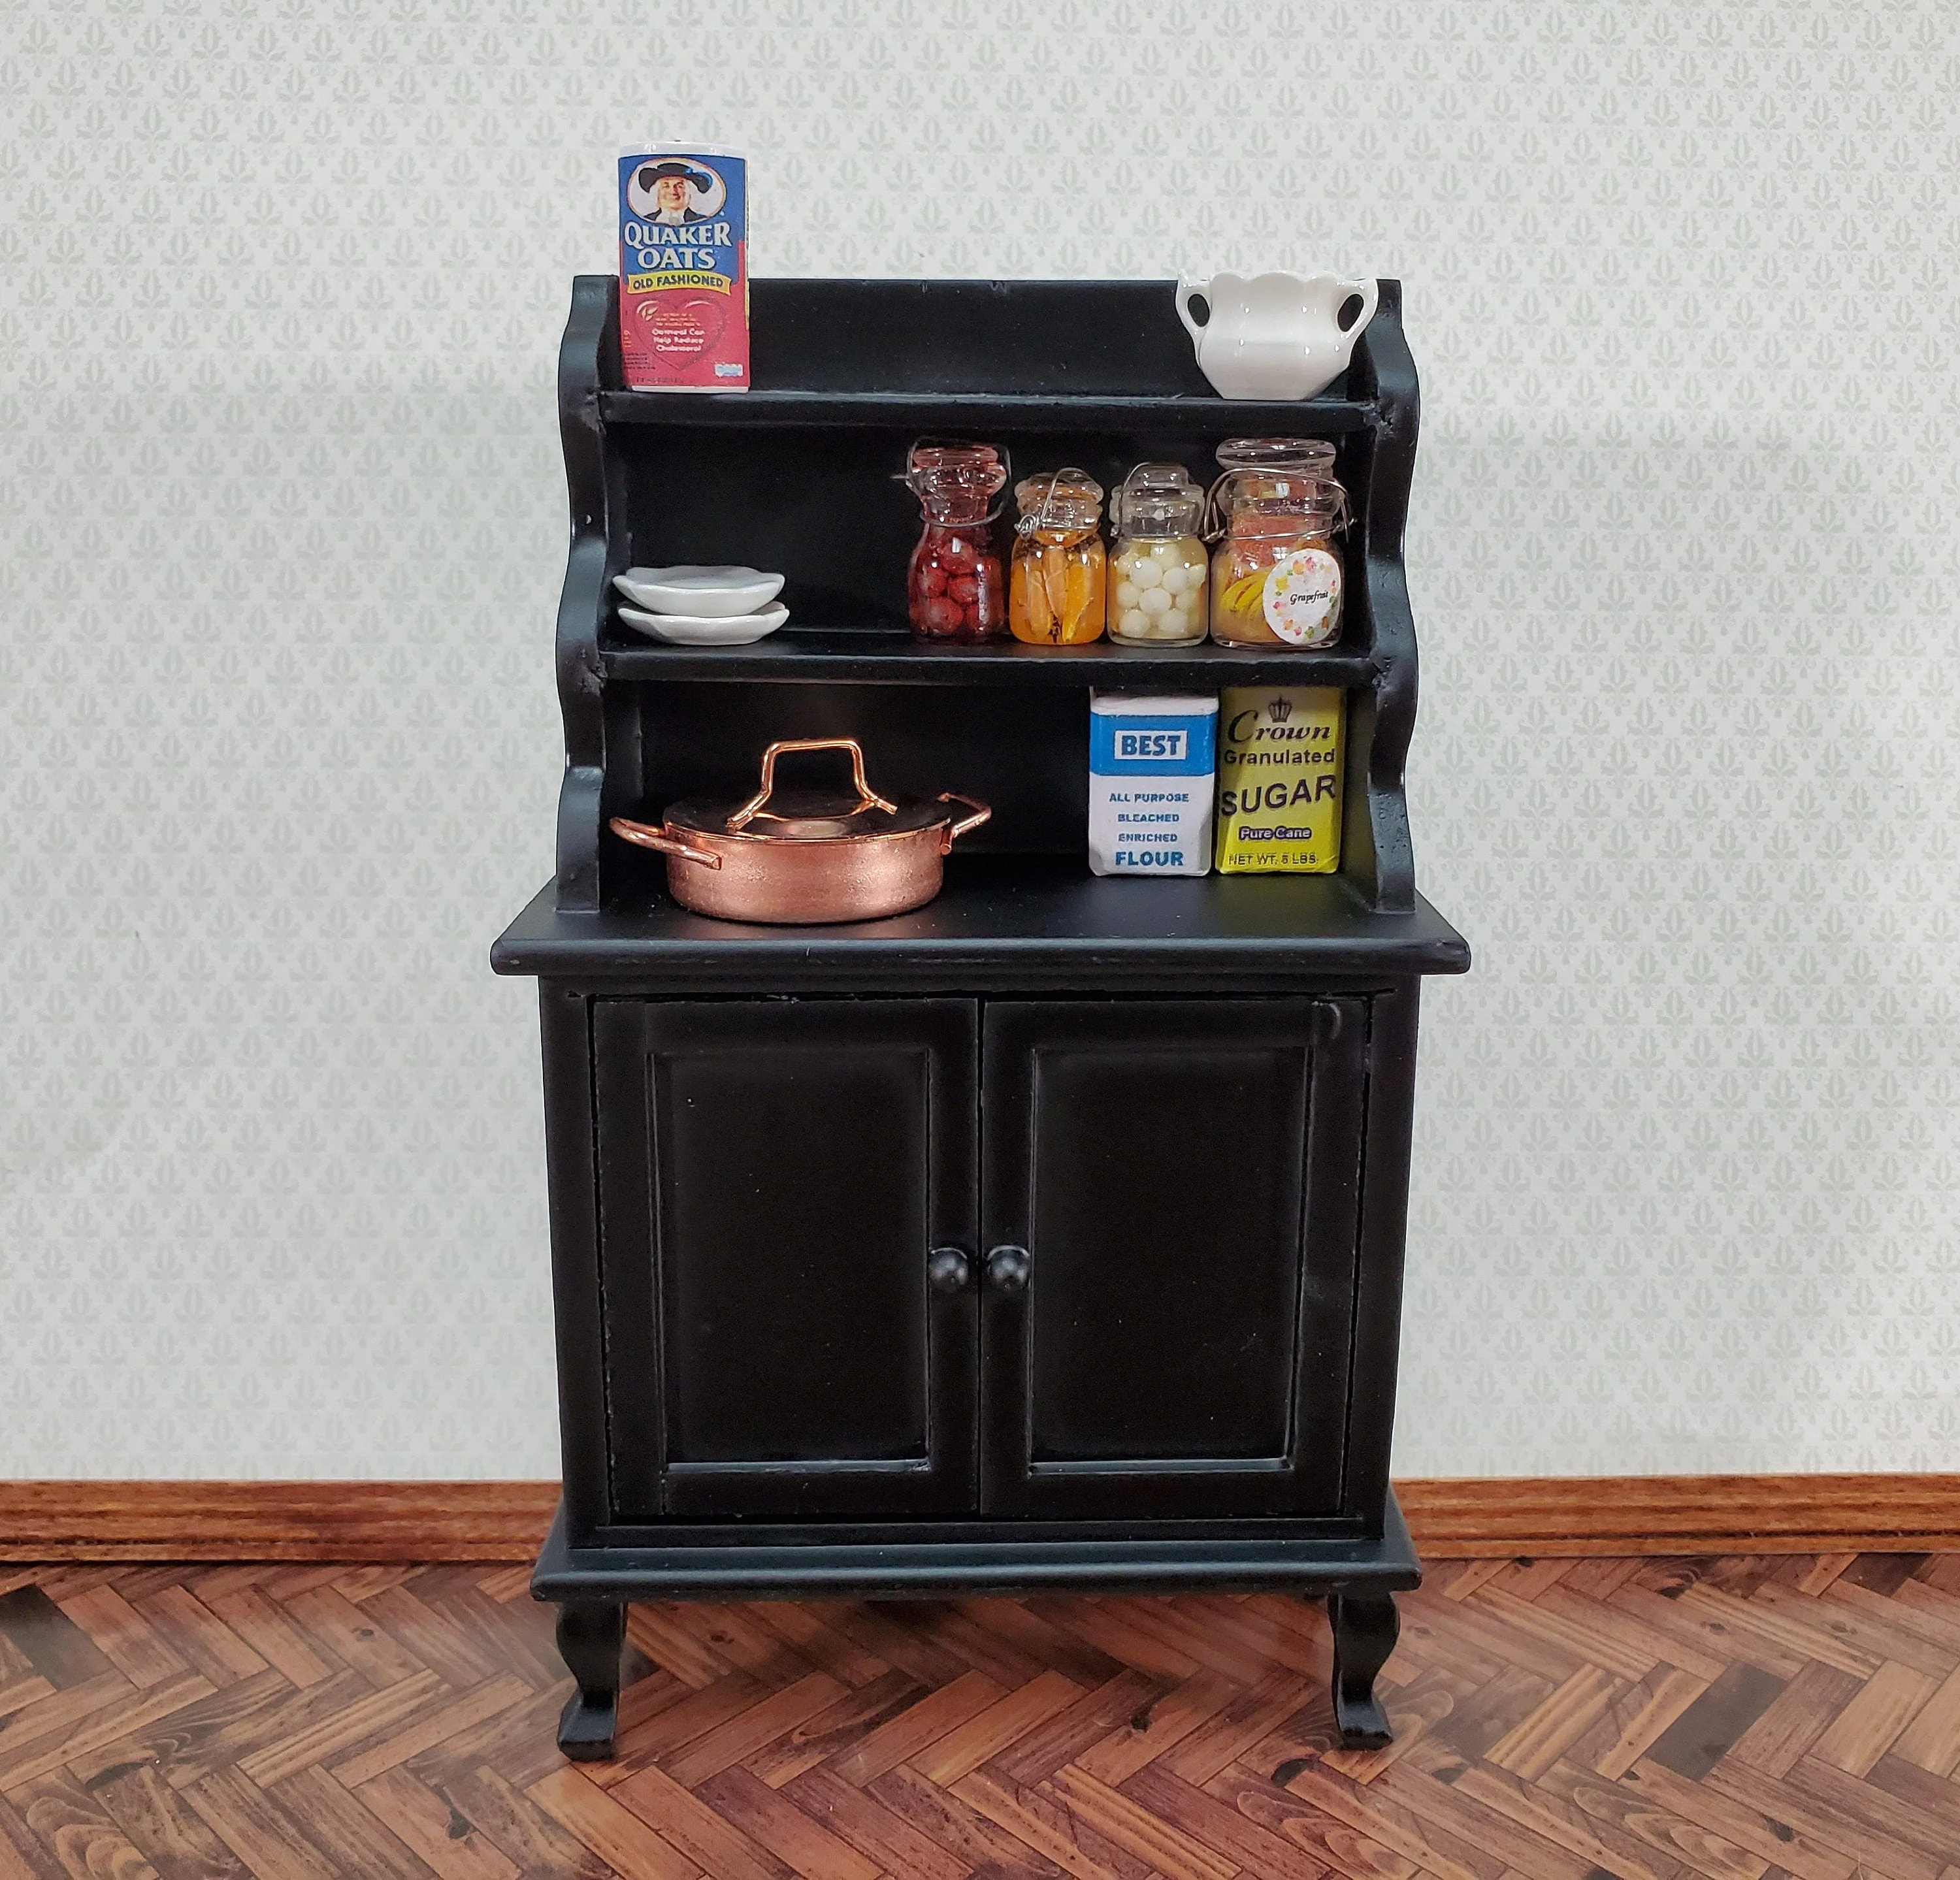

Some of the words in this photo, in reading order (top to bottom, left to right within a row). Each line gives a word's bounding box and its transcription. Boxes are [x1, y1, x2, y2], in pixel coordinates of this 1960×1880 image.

[624, 221, 732, 250] QUAKER
[637, 247, 716, 269] OATS
[632, 277, 653, 289] OLD
[657, 274, 723, 287] FASHIONED
[1228, 709, 1330, 743] Crown
[1121, 735, 1181, 756] BEST
[1224, 749, 1335, 764] Granulated
[1109, 793, 1130, 802] ALL
[1134, 793, 1189, 802] PURPOSE
[1221, 775, 1336, 815] SUGAR
[1118, 834, 1178, 842] ENRICHED
[1240, 828, 1272, 838] Pure
[1275, 827, 1311, 838] Cane
[1115, 852, 1184, 866] FLOUR
[1229, 854, 1252, 865] NET
